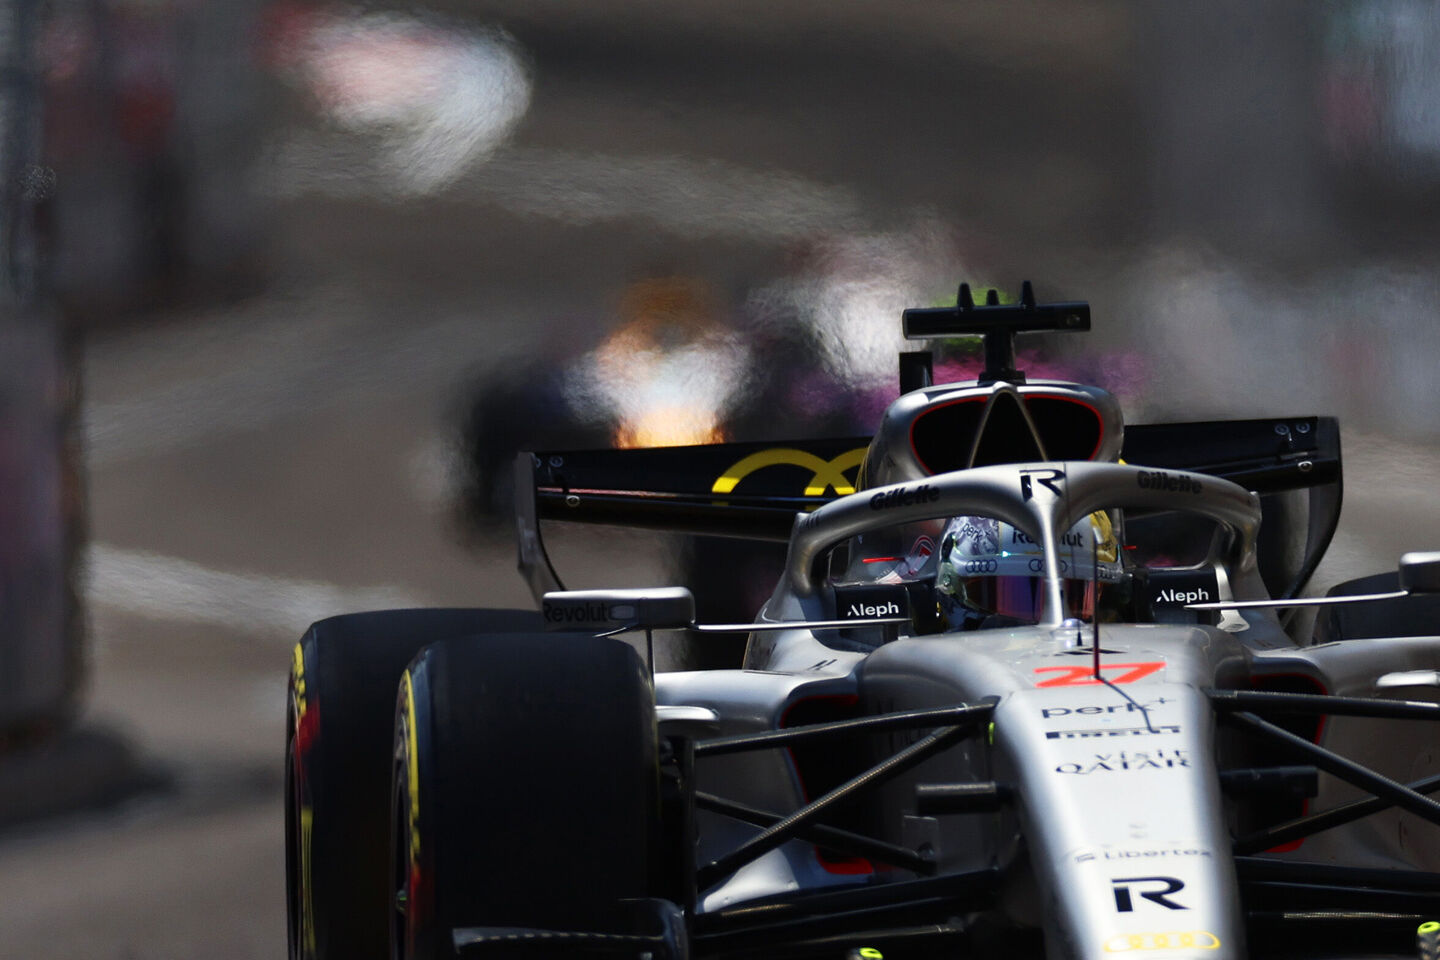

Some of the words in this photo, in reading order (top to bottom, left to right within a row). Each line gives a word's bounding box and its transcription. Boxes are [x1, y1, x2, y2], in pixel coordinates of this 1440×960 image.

[1136, 470, 1203, 495] Gillette
[869, 484, 941, 511] Gillette
[1156, 587, 1209, 603] Aleph
[847, 601, 899, 617] Aleph
[1033, 661, 1166, 688] 27
[1111, 876, 1191, 912] R
